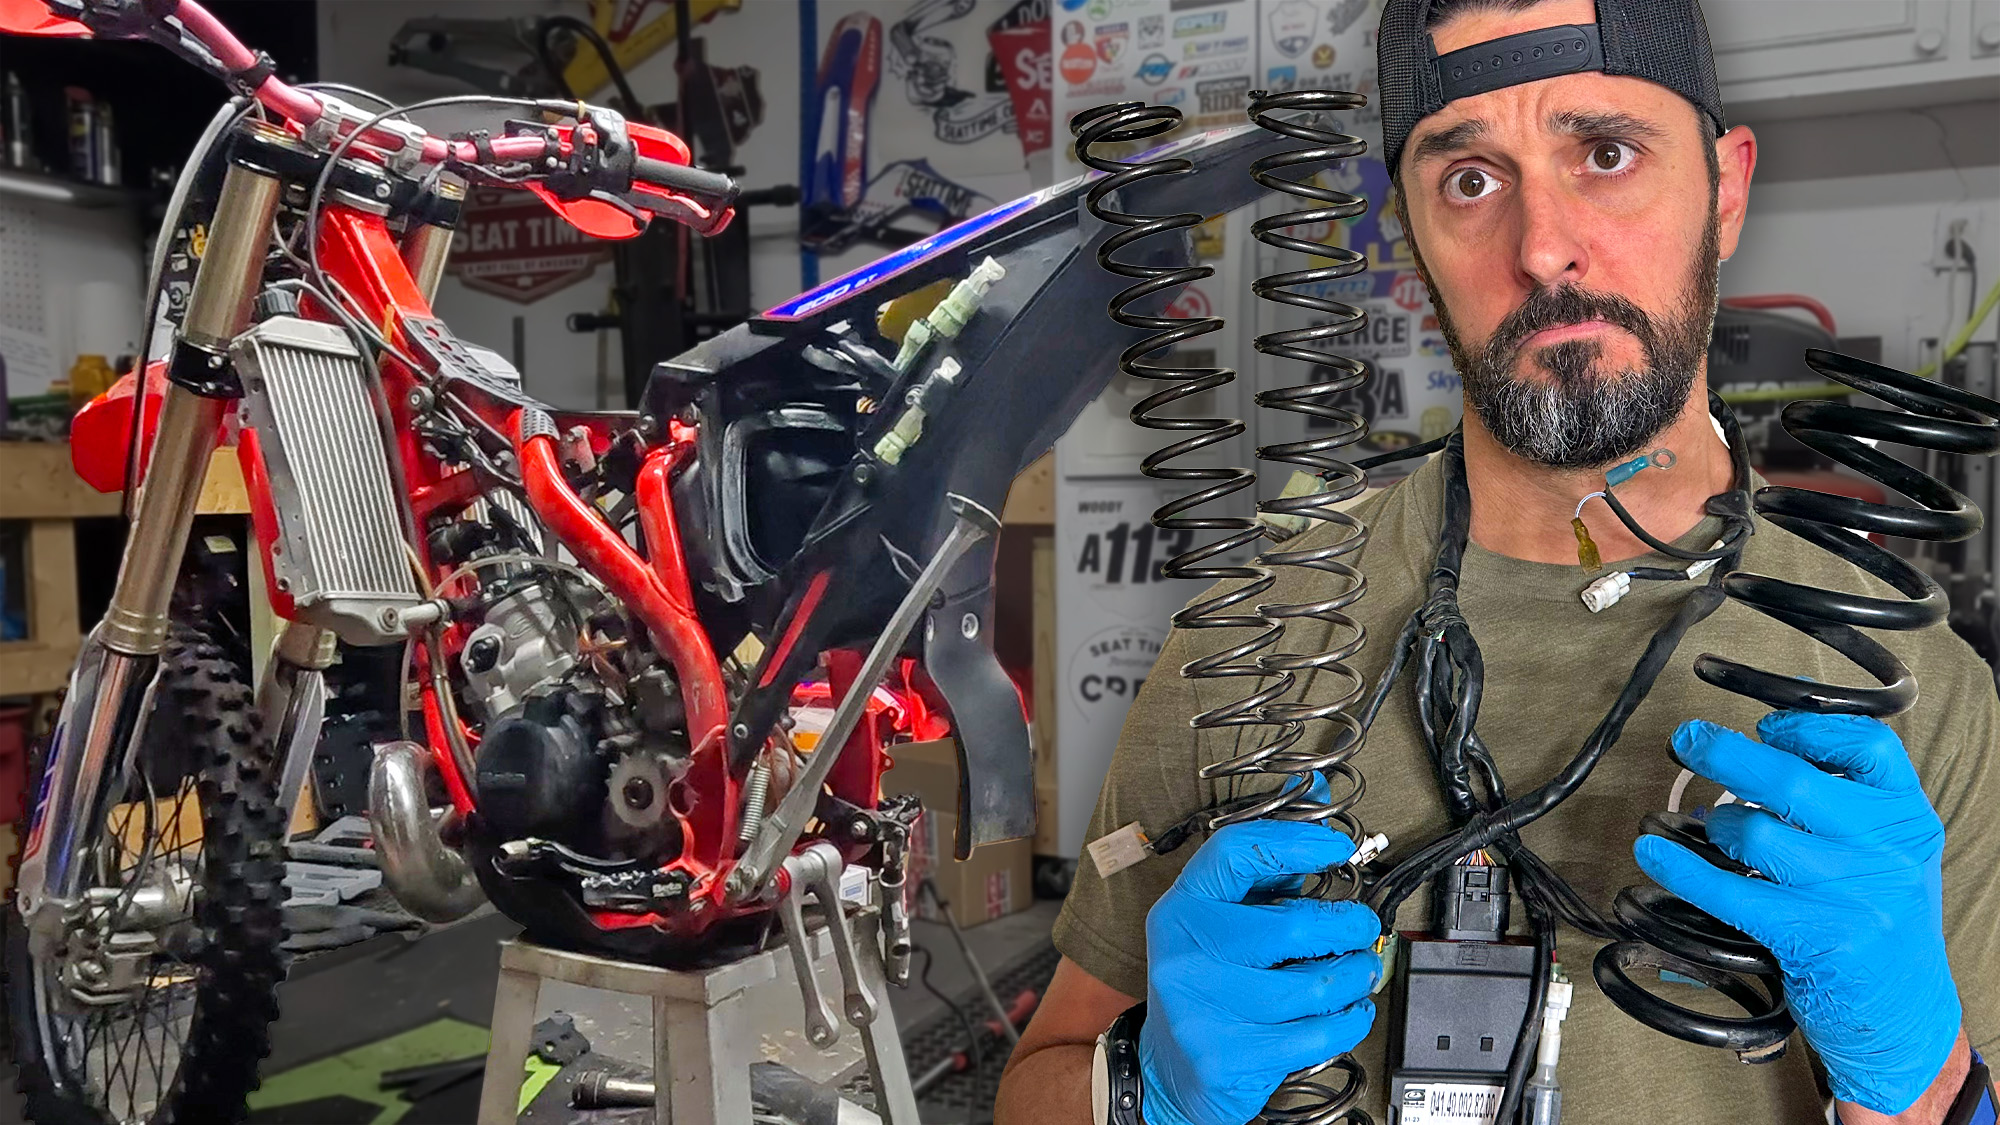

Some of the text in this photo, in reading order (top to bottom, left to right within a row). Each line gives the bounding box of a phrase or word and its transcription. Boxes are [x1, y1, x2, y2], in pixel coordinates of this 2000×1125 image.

[1199, 92, 1246, 114] RIDE
[452, 217, 598, 253] SEAT TIM
[1077, 501, 1124, 514] WOODY
[1077, 522, 1195, 584] A113
[1089, 638, 1133, 658] SEAT
